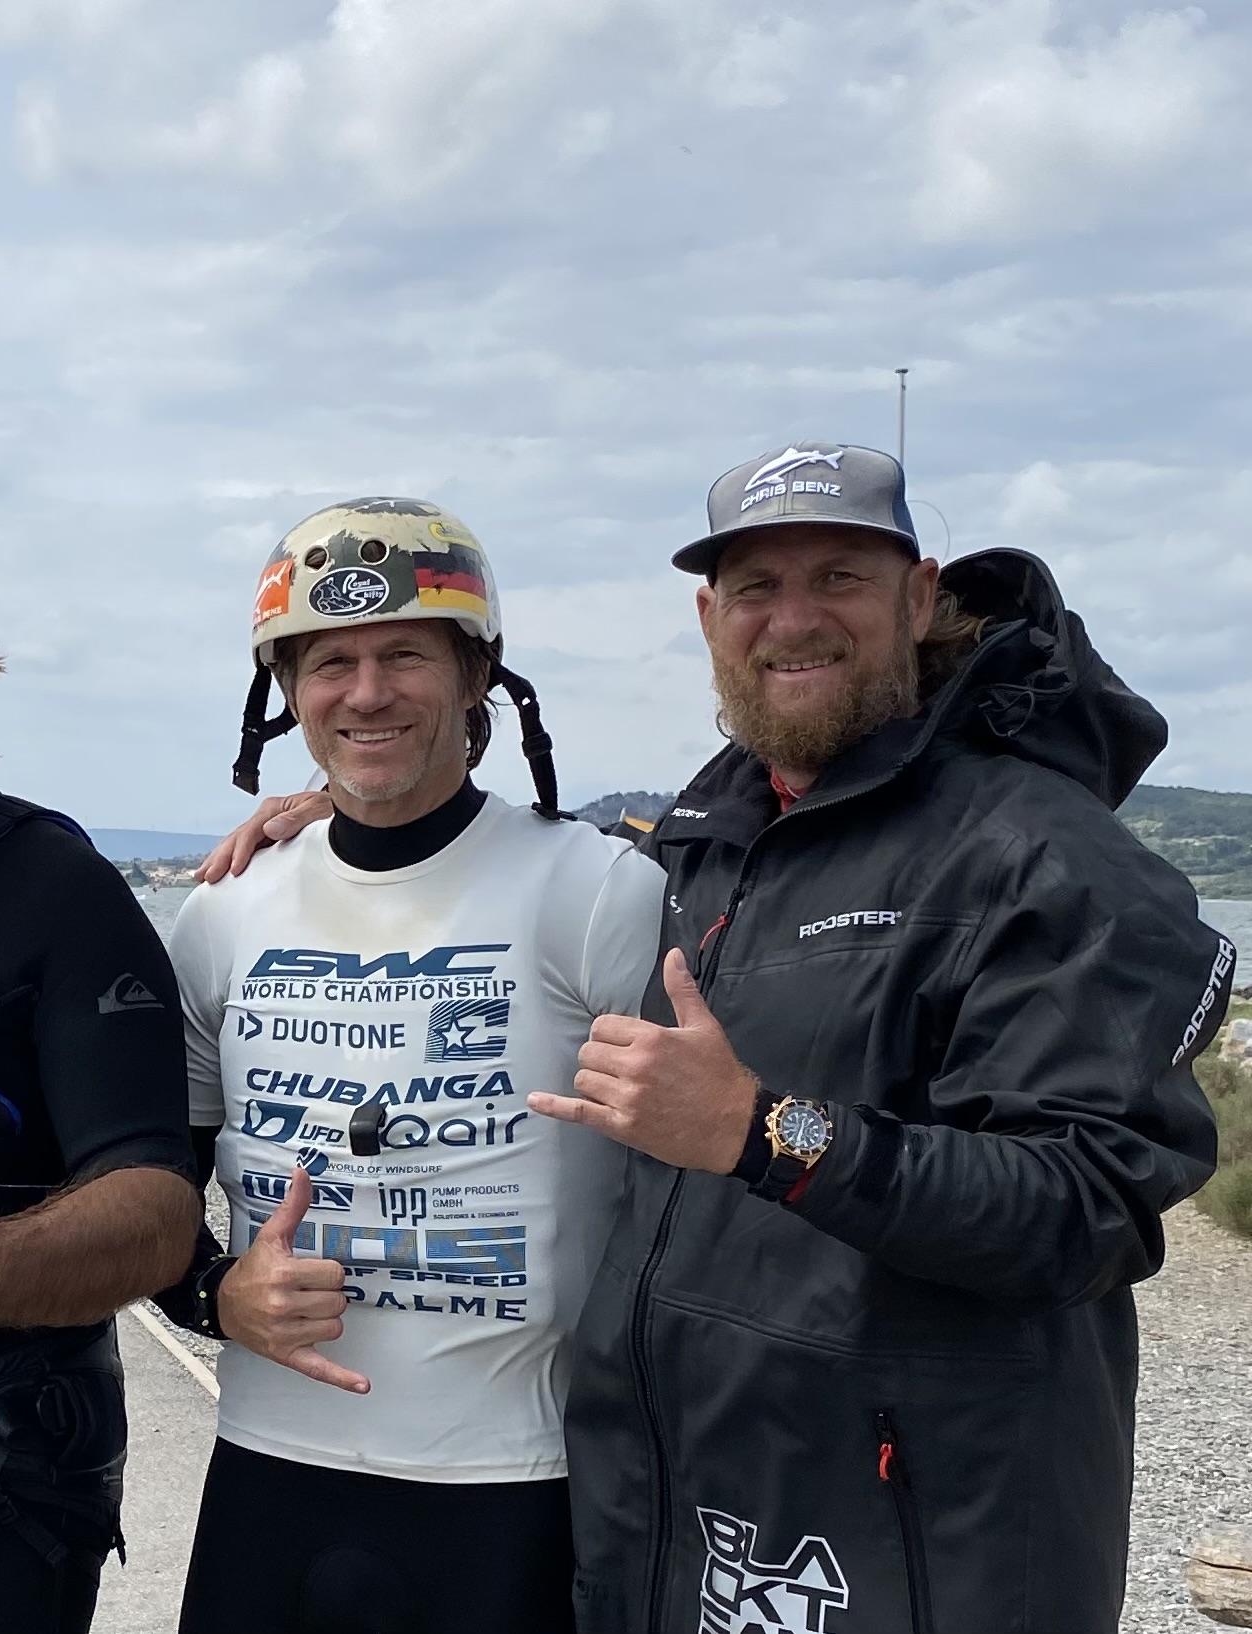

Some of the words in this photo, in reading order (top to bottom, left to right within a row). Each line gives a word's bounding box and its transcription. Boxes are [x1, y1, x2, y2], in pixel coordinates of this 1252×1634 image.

[741, 484, 787, 512] CHRIS
[792, 480, 842, 497] BENZ
[242, 982, 317, 1001] WORLD
[324, 980, 517, 1003] CHAMPIONSHIP
[272, 1017, 406, 1049] DUOTONE
[246, 1067, 515, 1106] CHUBANGA
[299, 1123, 345, 1143] UFO
[379, 1102, 529, 1149] Qair
[327, 1163, 365, 1173] WORLD
[367, 1166, 384, 1174] OF
[385, 1165, 443, 1174] WINDSURF
[432, 1187, 462, 1197] PUMP
[464, 1184, 520, 1196] PRODUCTS
[432, 1199, 463, 1208] GMBH
[389, 1269, 527, 1288] SPEED
